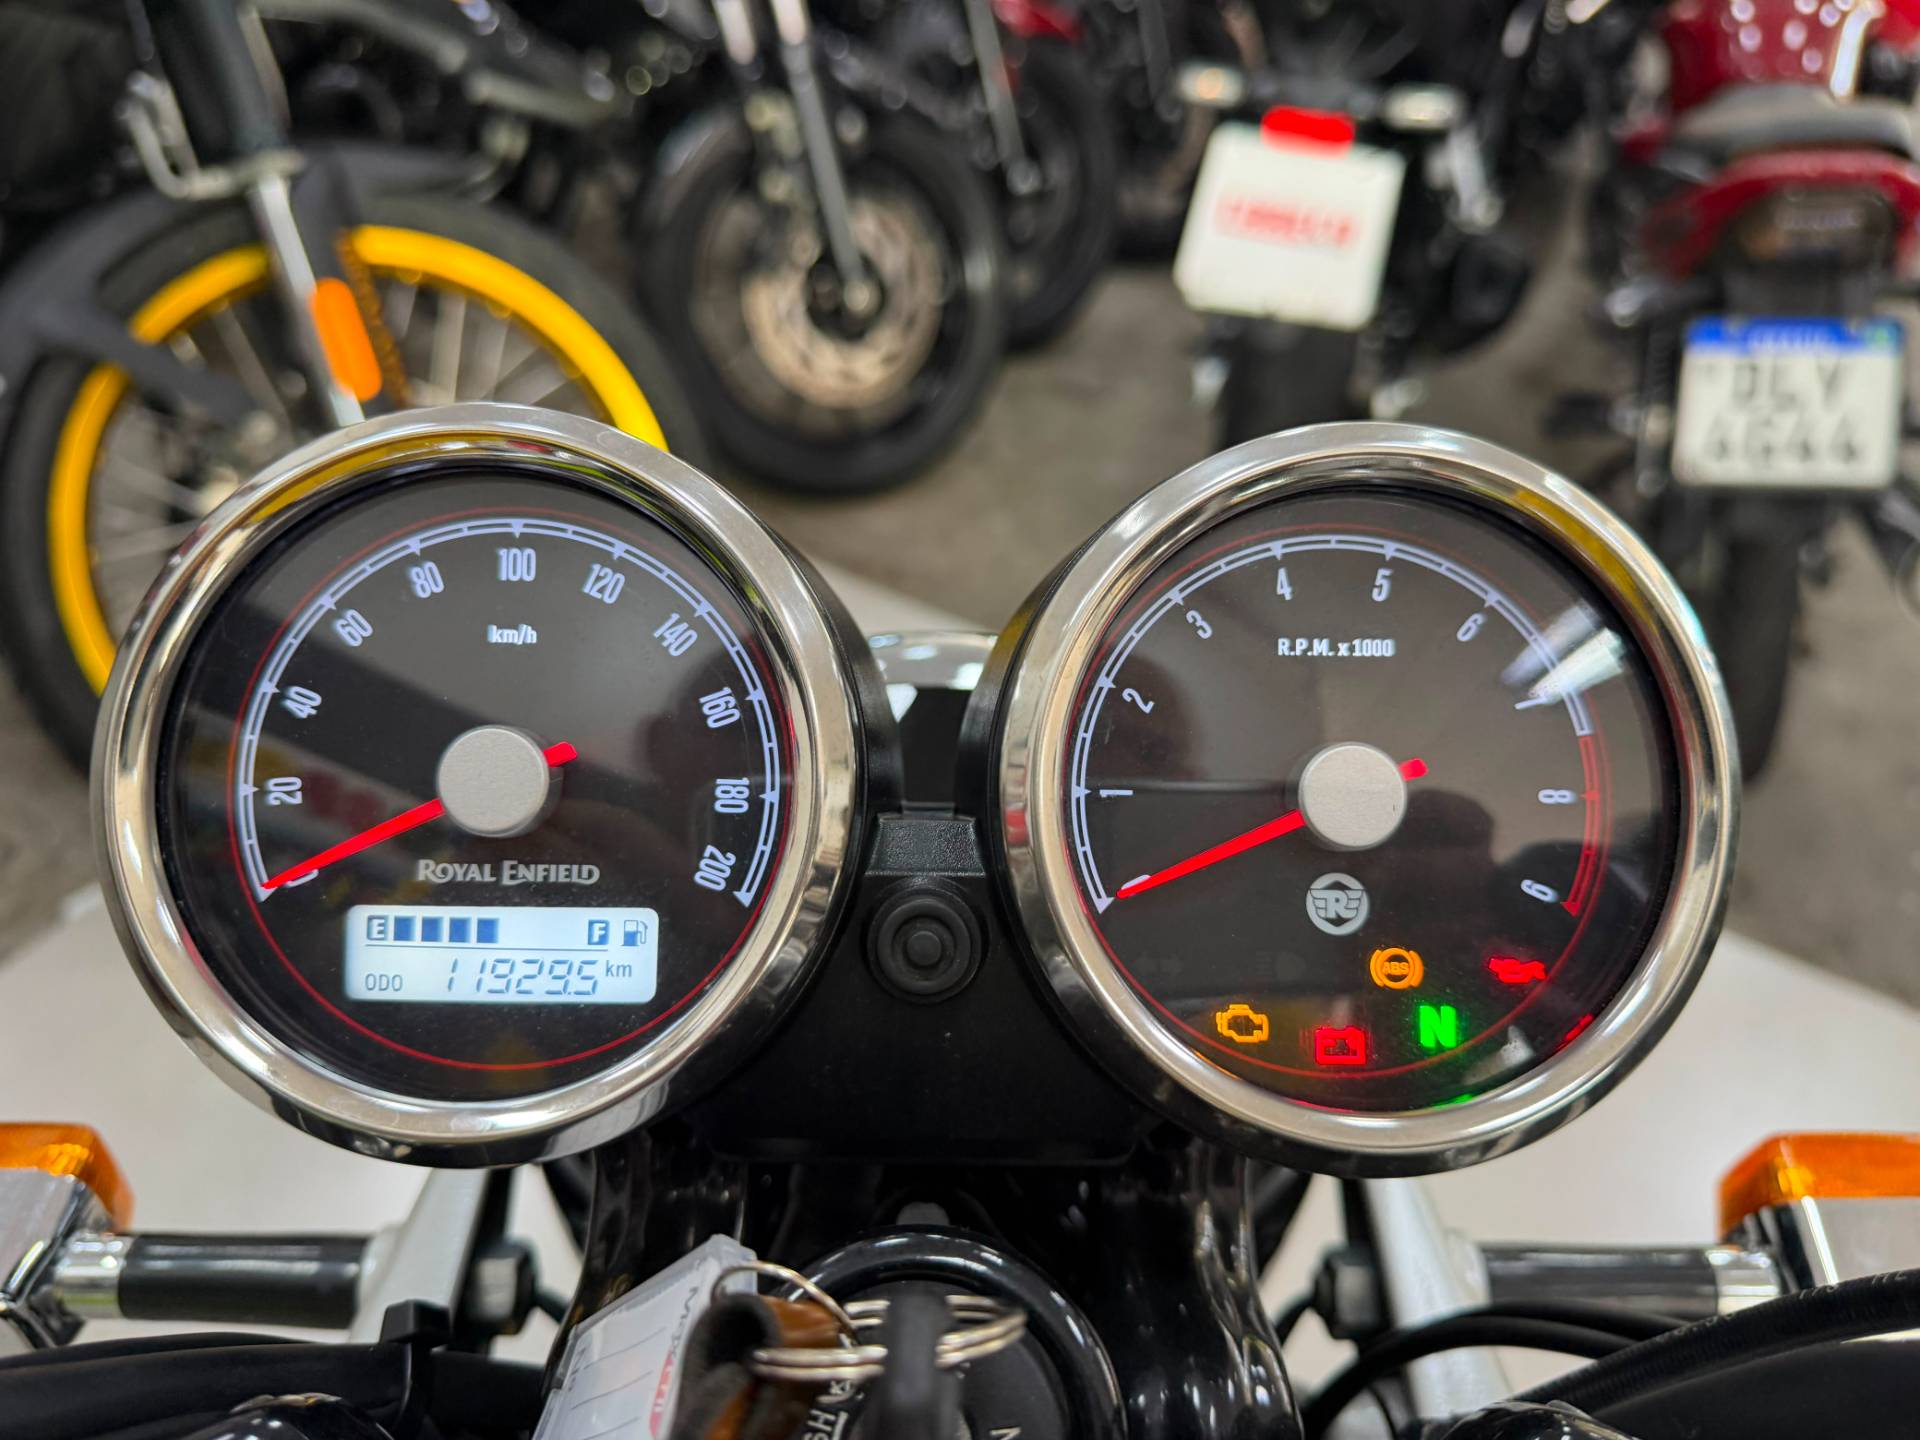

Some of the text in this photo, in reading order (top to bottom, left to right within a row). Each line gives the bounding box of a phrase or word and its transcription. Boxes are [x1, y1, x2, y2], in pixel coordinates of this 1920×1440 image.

[410, 561, 445, 599] 80
[498, 548, 537, 582] 100
[582, 563, 626, 604] 120
[1276, 567, 1293, 601] 4
[1372, 568, 1393, 602] 5
[334, 608, 374, 647] 60
[487, 623, 538, 646] km/h
[653, 612, 698, 657] 140
[1185, 609, 1213, 640] 3
[1456, 613, 1485, 642] 6
[1277, 637, 1334, 657] R.P.M.
[1351, 638, 1395, 657] 1000
[282, 685, 322, 719] 40
[698, 686, 741, 729] 160
[1121, 687, 1155, 714] 2
[266, 776, 303, 806] 20
[714, 776, 751, 814] 180
[1537, 788, 1575, 805] 8
[416, 859, 601, 886] ROYAL ENFIELD
[693, 844, 737, 892] 200
[1520, 879, 1558, 903] 9
[368, 916, 387, 941] E
[589, 920, 608, 945] F
[364, 972, 404, 992] ODO
[604, 959, 633, 979] km
[1382, 961, 1410, 977] ABS
[1419, 1004, 1457, 1049] N
